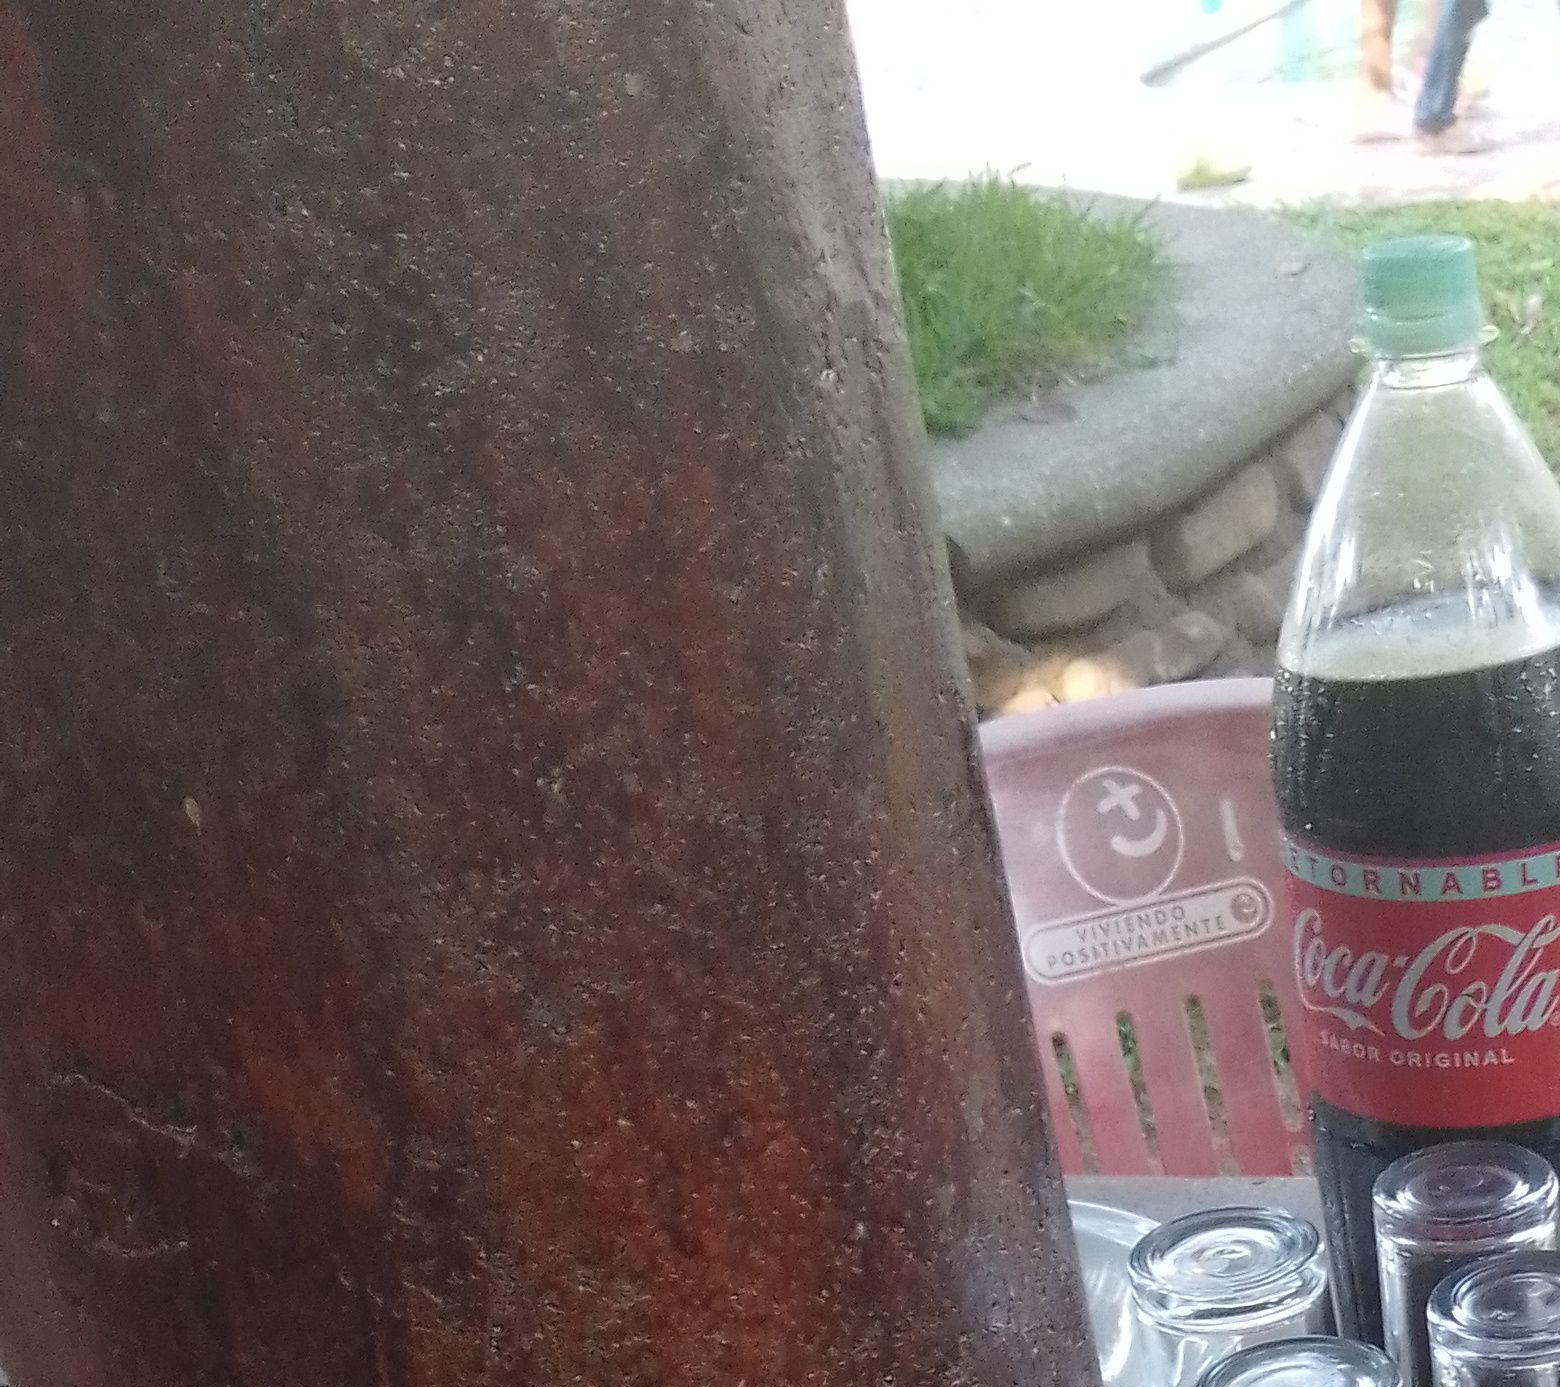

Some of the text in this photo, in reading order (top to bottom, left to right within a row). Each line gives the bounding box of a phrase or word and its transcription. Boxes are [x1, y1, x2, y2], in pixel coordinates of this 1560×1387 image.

[1048, 914, 1226, 969] POSITIVAMENTE
[1076, 905, 1185, 942] VIVIENDO
[1390, 1048, 1516, 1069] ORIGINAL
